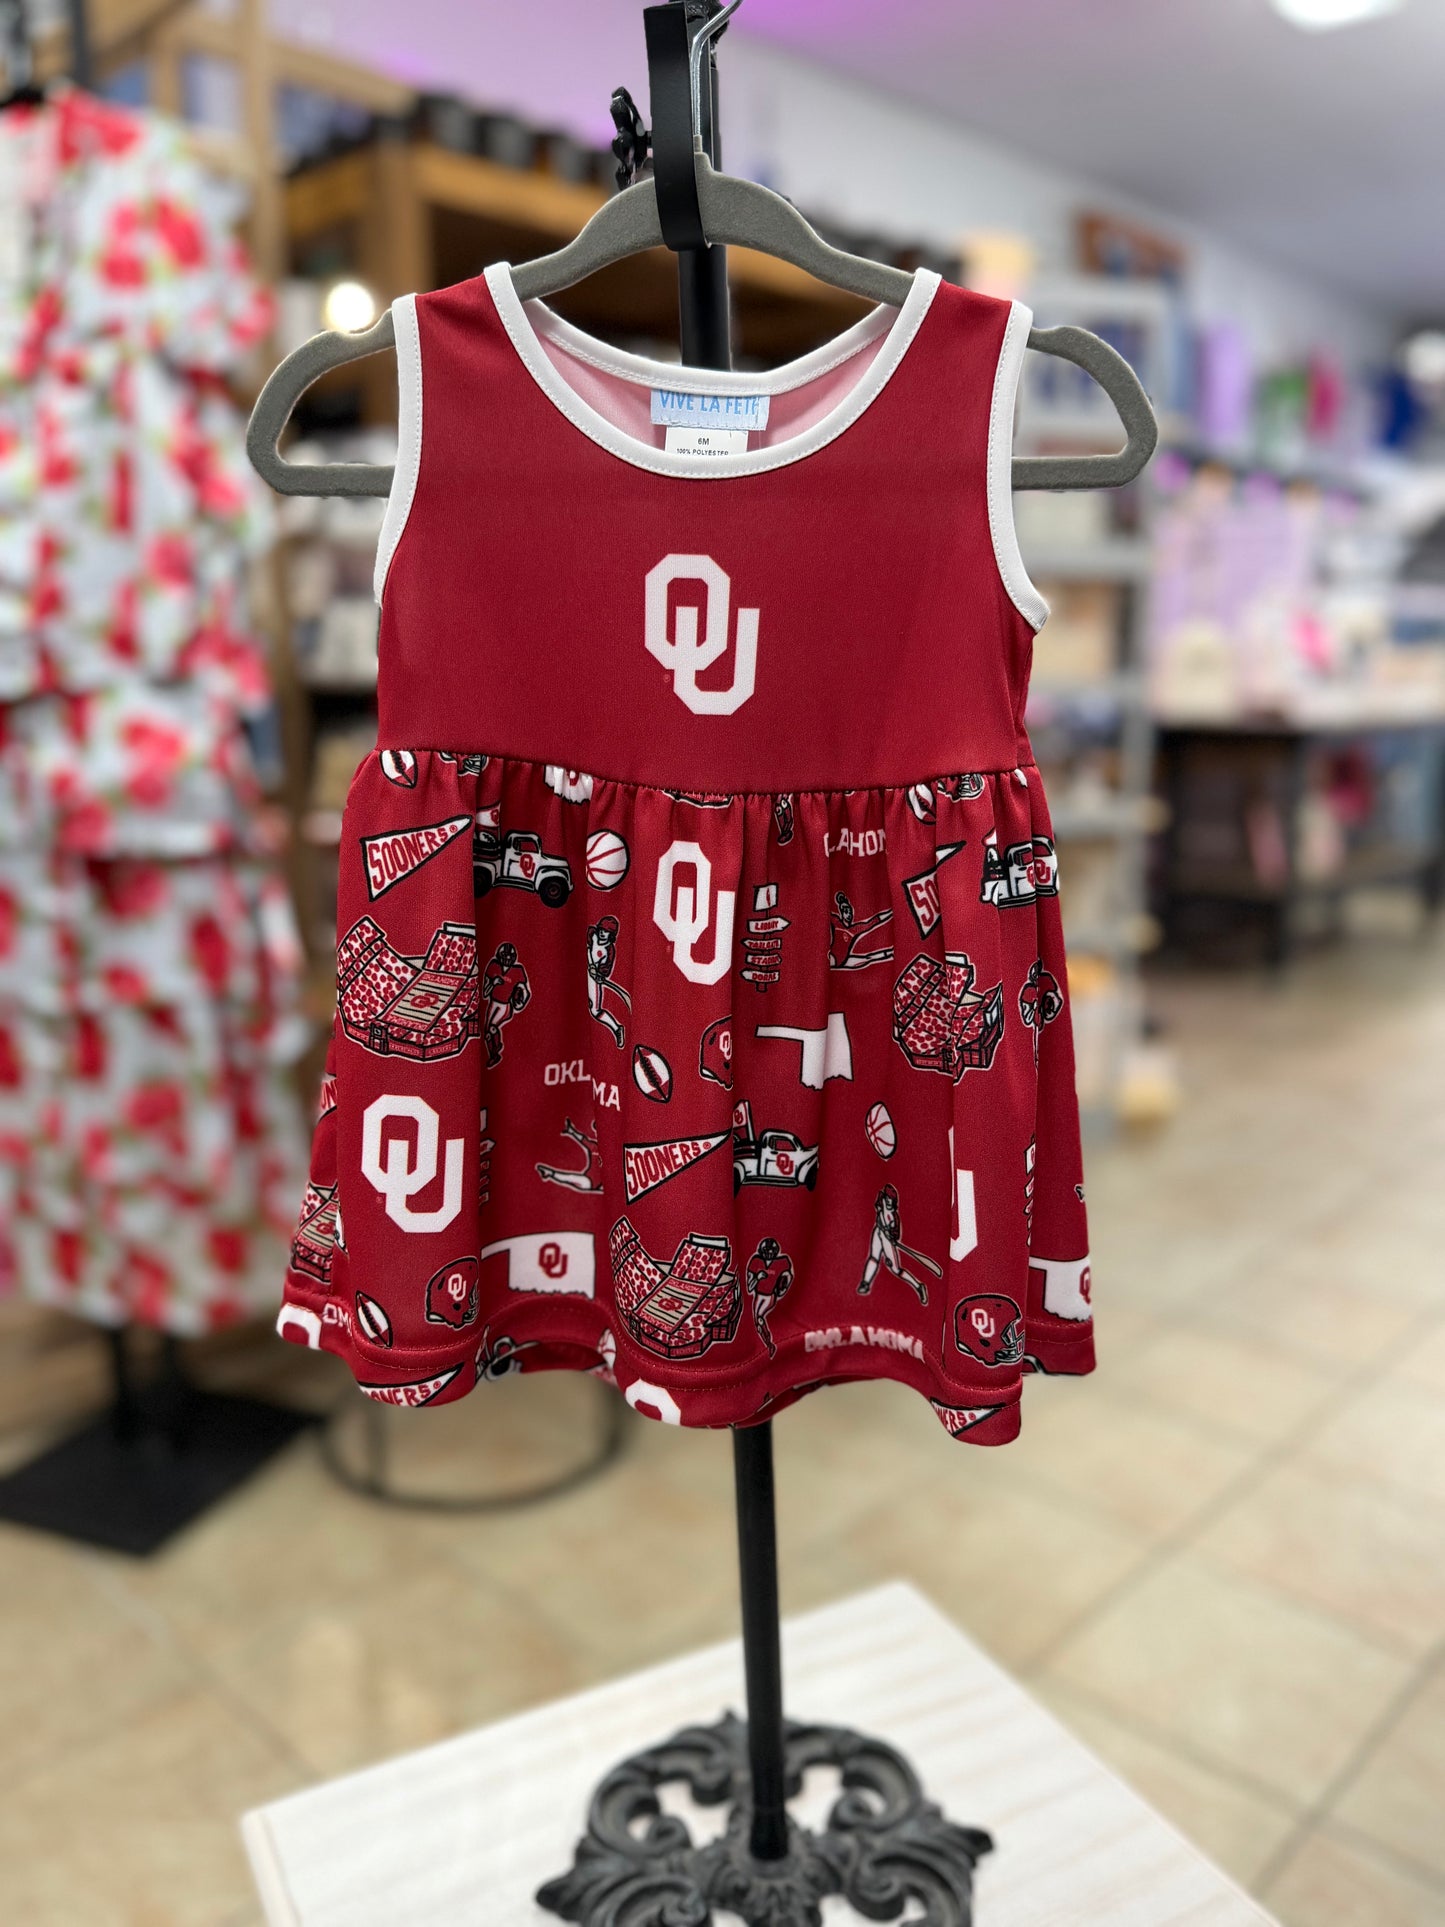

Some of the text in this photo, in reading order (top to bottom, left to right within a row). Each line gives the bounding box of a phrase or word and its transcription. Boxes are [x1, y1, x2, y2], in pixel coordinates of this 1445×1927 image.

[659, 390, 694, 411] VIVE
[700, 395, 720, 413] LA
[698, 438, 710, 446] 6M
[645, 554, 760, 716] OU
[367, 827, 449, 891] SOONERS
[520, 853, 536, 879] OU
[653, 840, 736, 986] OU
[361, 1094, 464, 1233] OU
[625, 1141, 702, 1197] SOONERS
[775, 1152, 794, 1176] OU
[538, 1242, 569, 1279] OU
[448, 1273, 467, 1301] OU
[971, 1308, 995, 1338] OU
